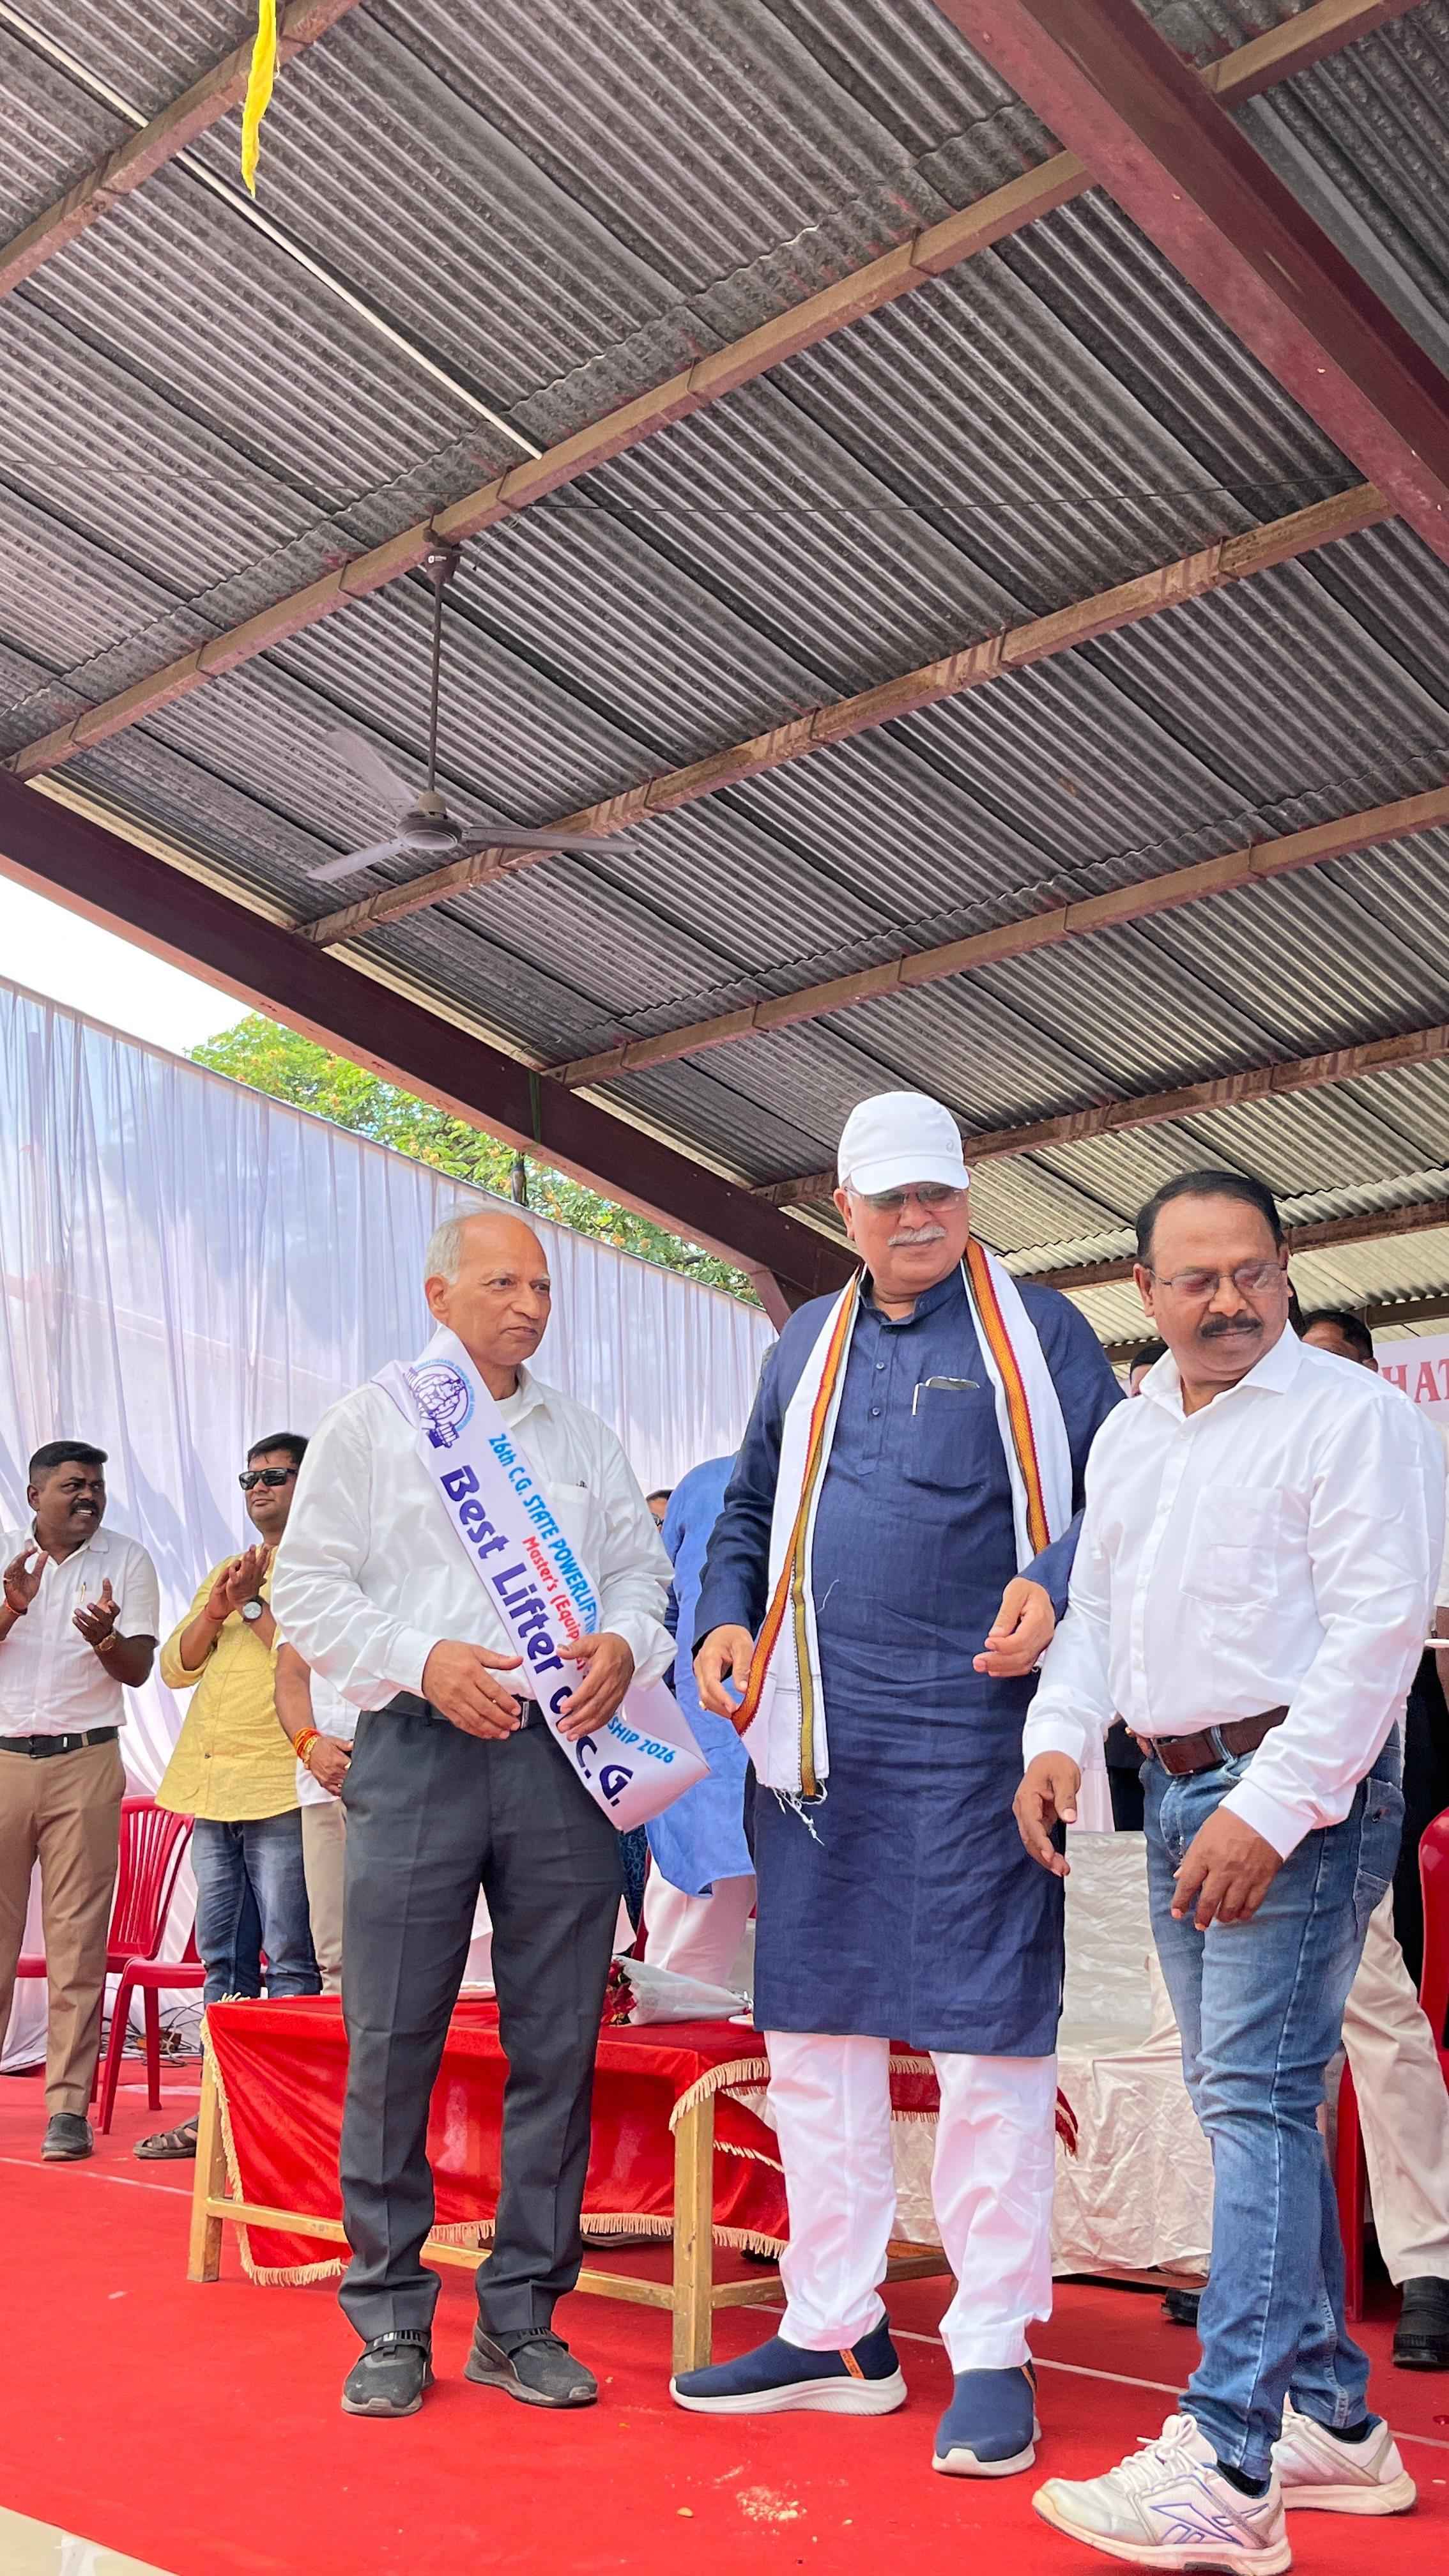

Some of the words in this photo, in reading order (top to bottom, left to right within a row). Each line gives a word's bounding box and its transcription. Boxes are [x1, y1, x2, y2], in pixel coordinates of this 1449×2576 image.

[440, 1464, 510, 1560] Best
[491, 1562, 564, 1675] Lifter
[576, 1735, 634, 1807] C.G.
[489, 1433, 516, 1467] 26th
[509, 1466, 532, 1496] C.G.
[523, 1494, 560, 1540] STATE
[608, 1712, 640, 1744] SHIP
[637, 1739, 676, 1763] 2026
[522, 1535, 559, 1592] Master's
